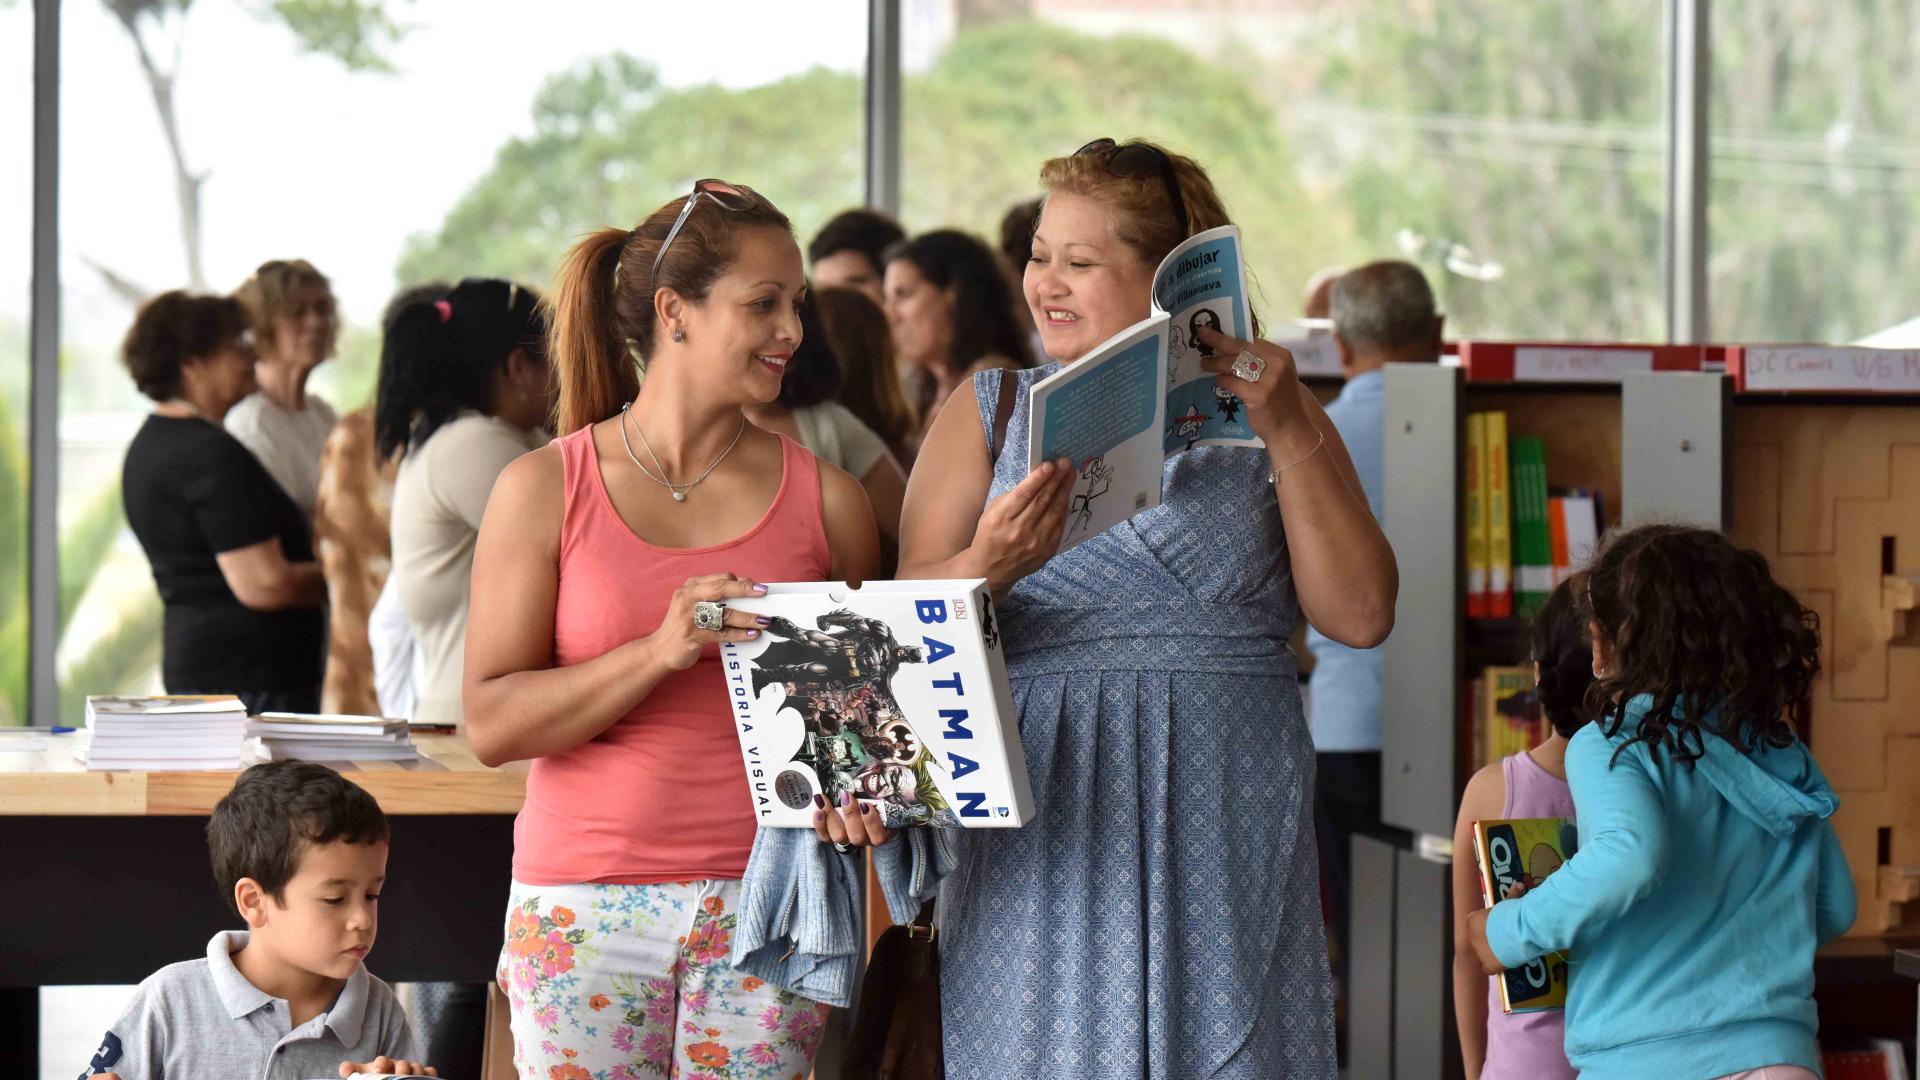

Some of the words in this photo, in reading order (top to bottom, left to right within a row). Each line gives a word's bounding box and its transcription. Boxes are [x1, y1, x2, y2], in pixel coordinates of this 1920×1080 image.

[1176, 249, 1220, 279] dibujar
[952, 599, 967, 619] DK
[914, 599, 990, 818] BATMAN
[747, 746, 772, 818] VISUAL
